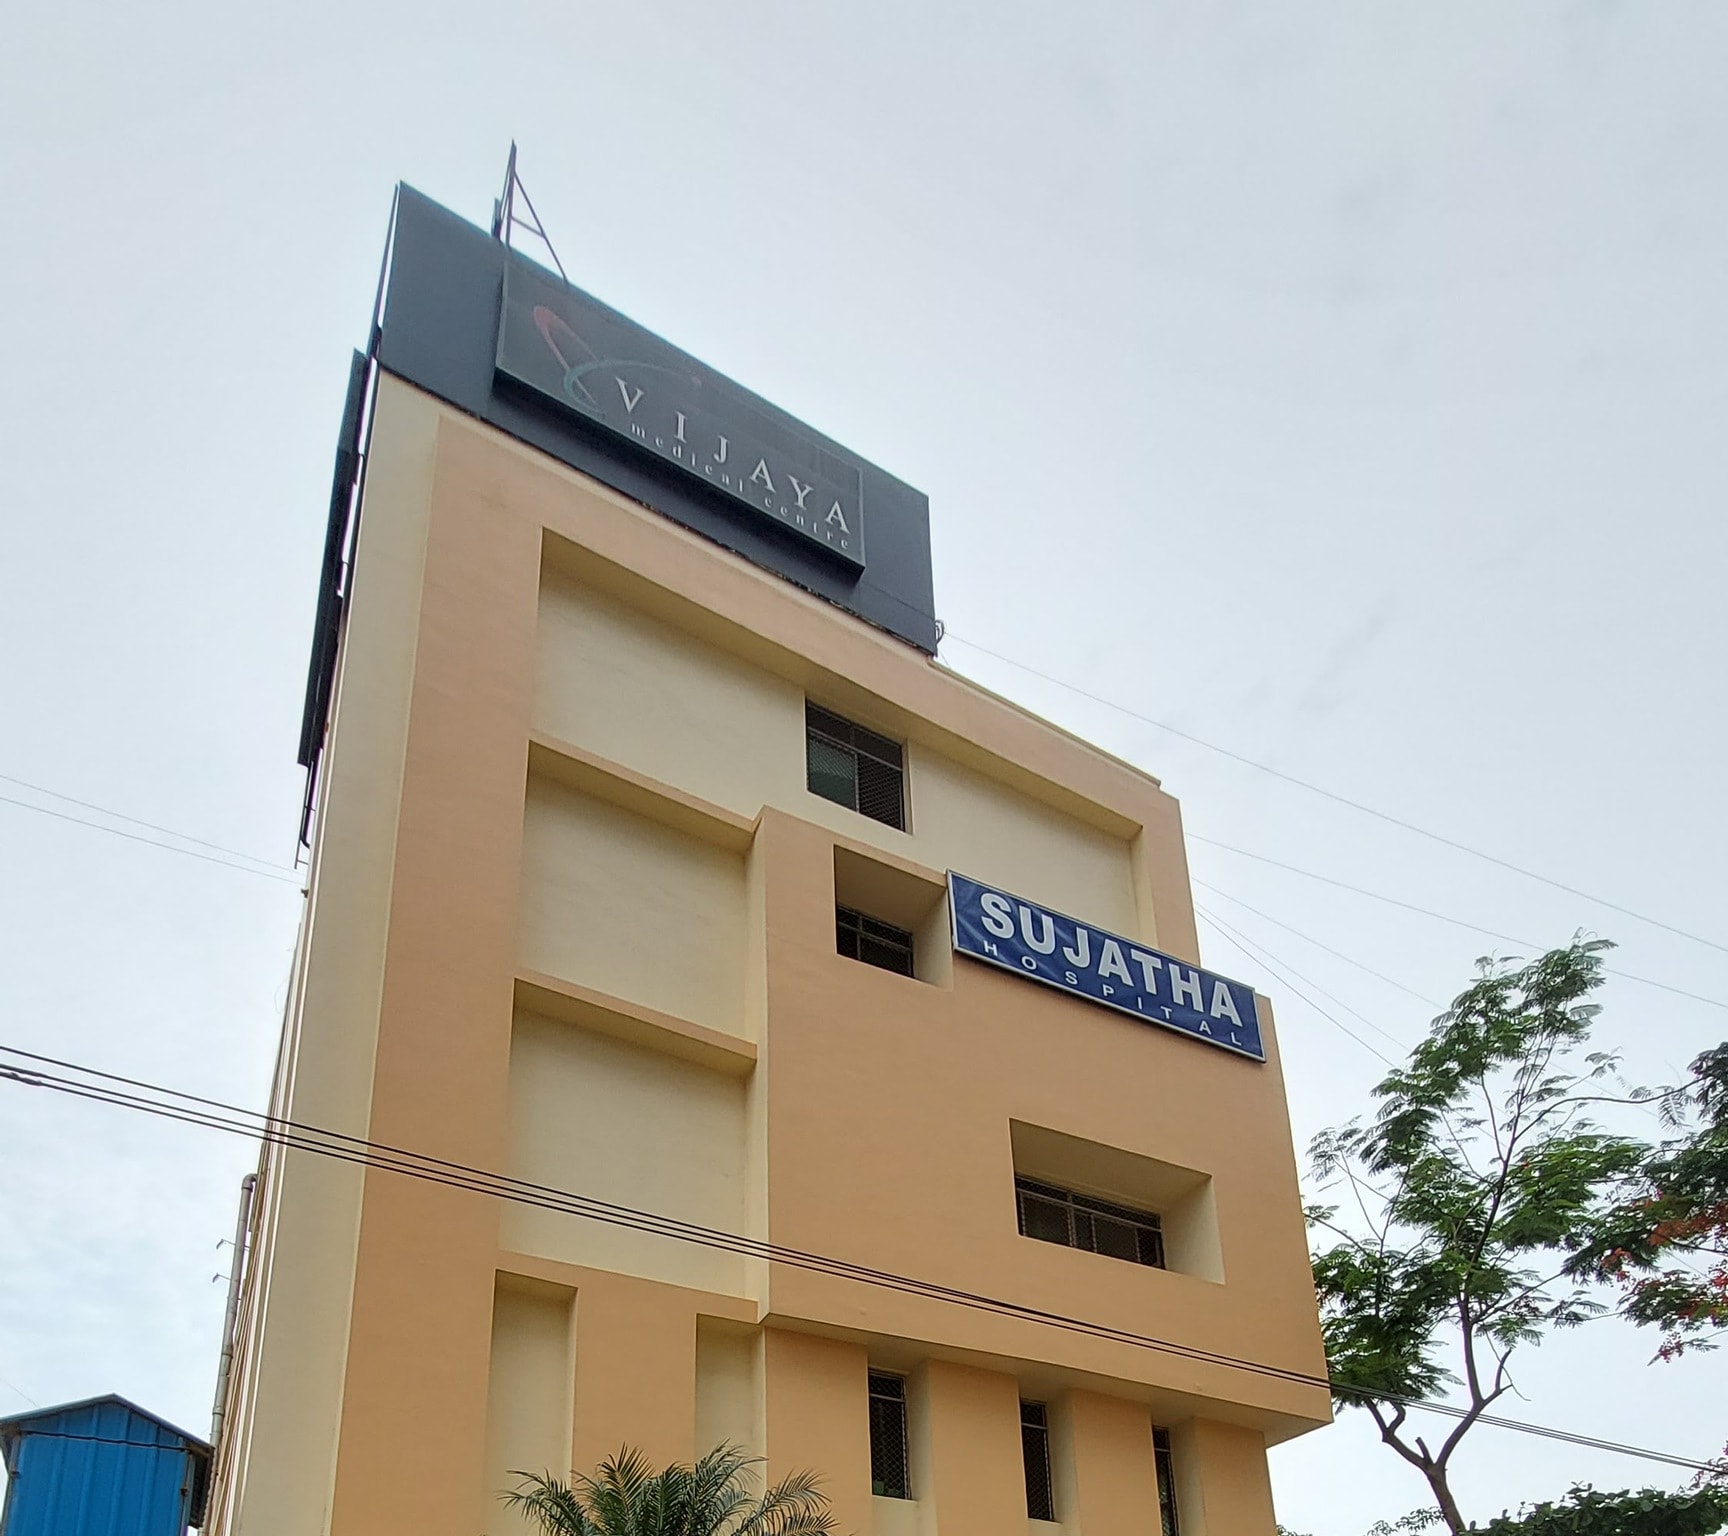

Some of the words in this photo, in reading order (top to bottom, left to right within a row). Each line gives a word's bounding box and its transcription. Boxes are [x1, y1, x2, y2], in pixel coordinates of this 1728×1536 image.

[615, 376, 850, 534] VIJAYA
[631, 423, 744, 493] medical
[980, 892, 1243, 1027] SUJATHA
[984, 940, 1242, 1046] HOSPITAL
